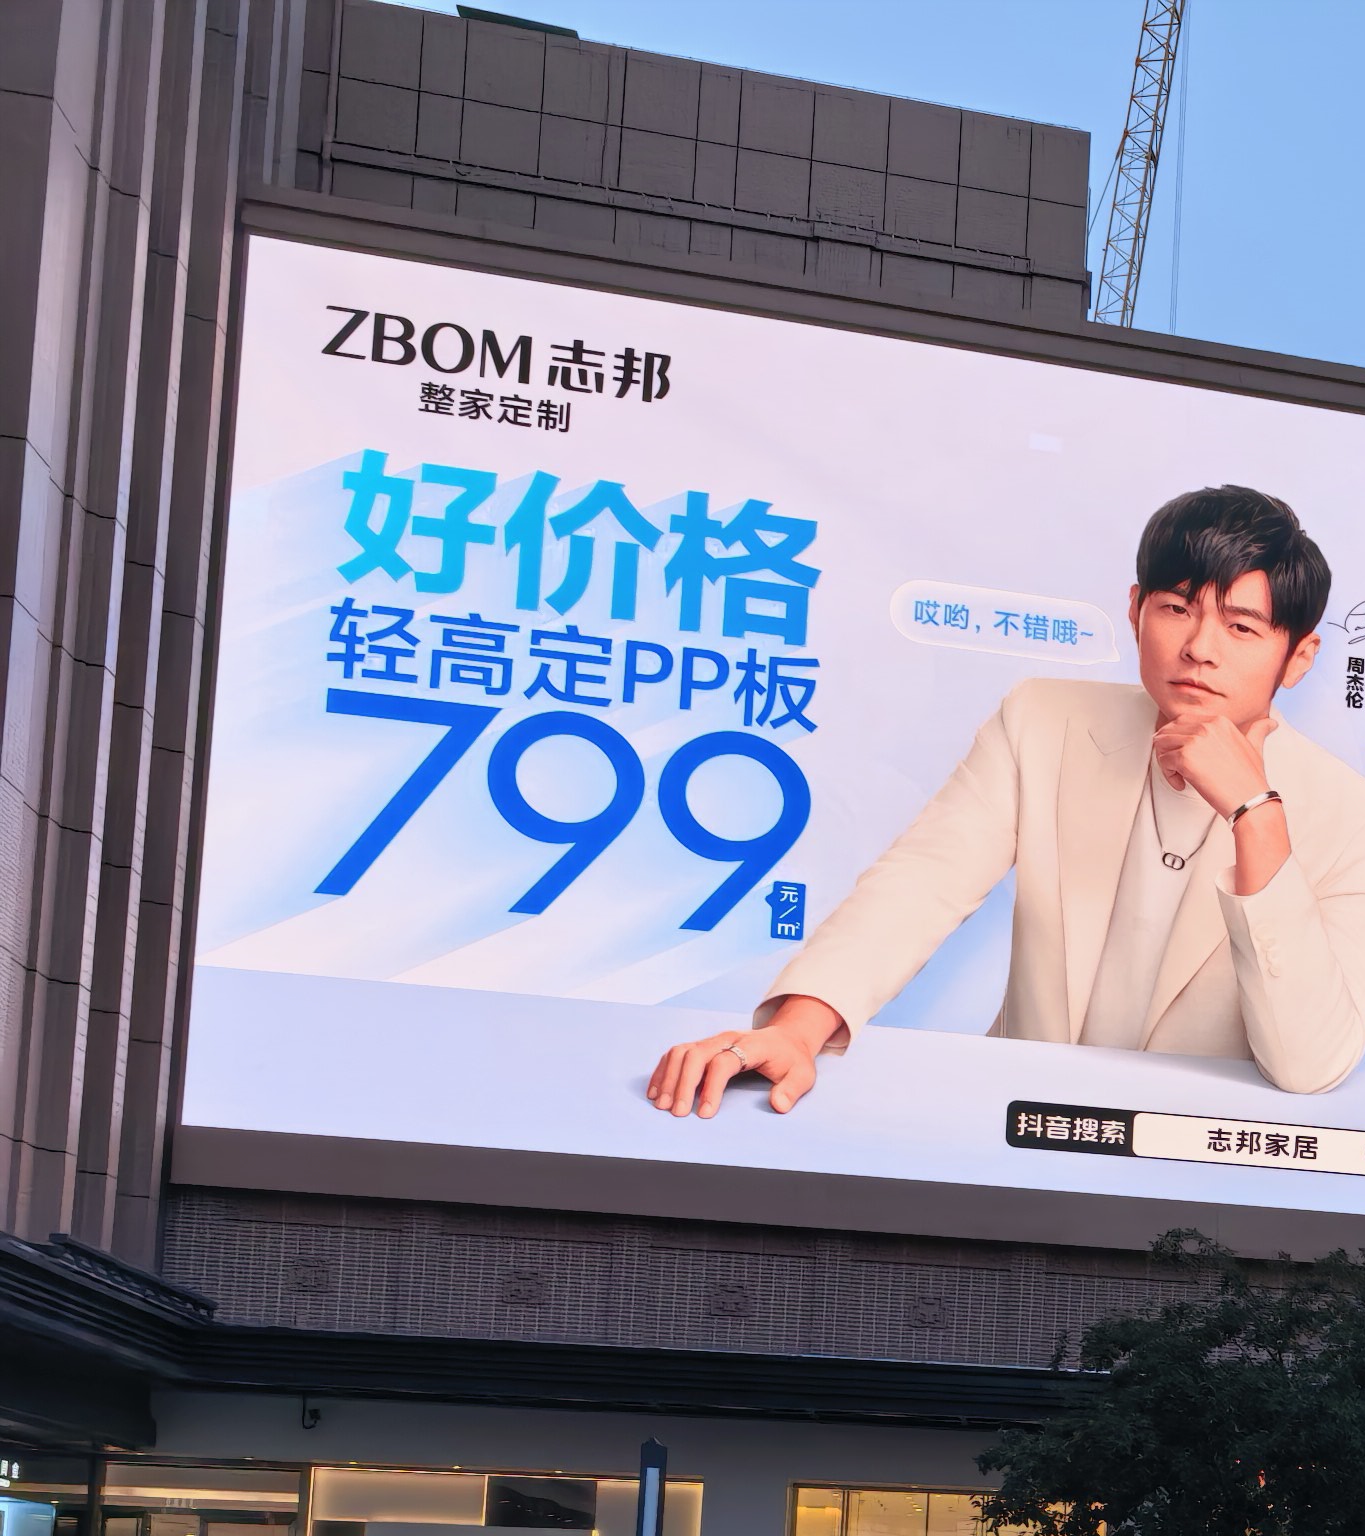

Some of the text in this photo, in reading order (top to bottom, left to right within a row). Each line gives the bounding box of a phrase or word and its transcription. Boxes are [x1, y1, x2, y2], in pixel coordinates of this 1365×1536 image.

[320, 304, 672, 403] ZBOM 志邦
[418, 381, 571, 433] 整家定制
[335, 448, 822, 647] 好价格
[326, 597, 821, 733] 轻高定PP板
[1344, 656, 1365, 710] 周杰伦
[313, 687, 812, 932] 799
[1017, 1111, 1319, 1164] 抖音搜索 志邦家居
